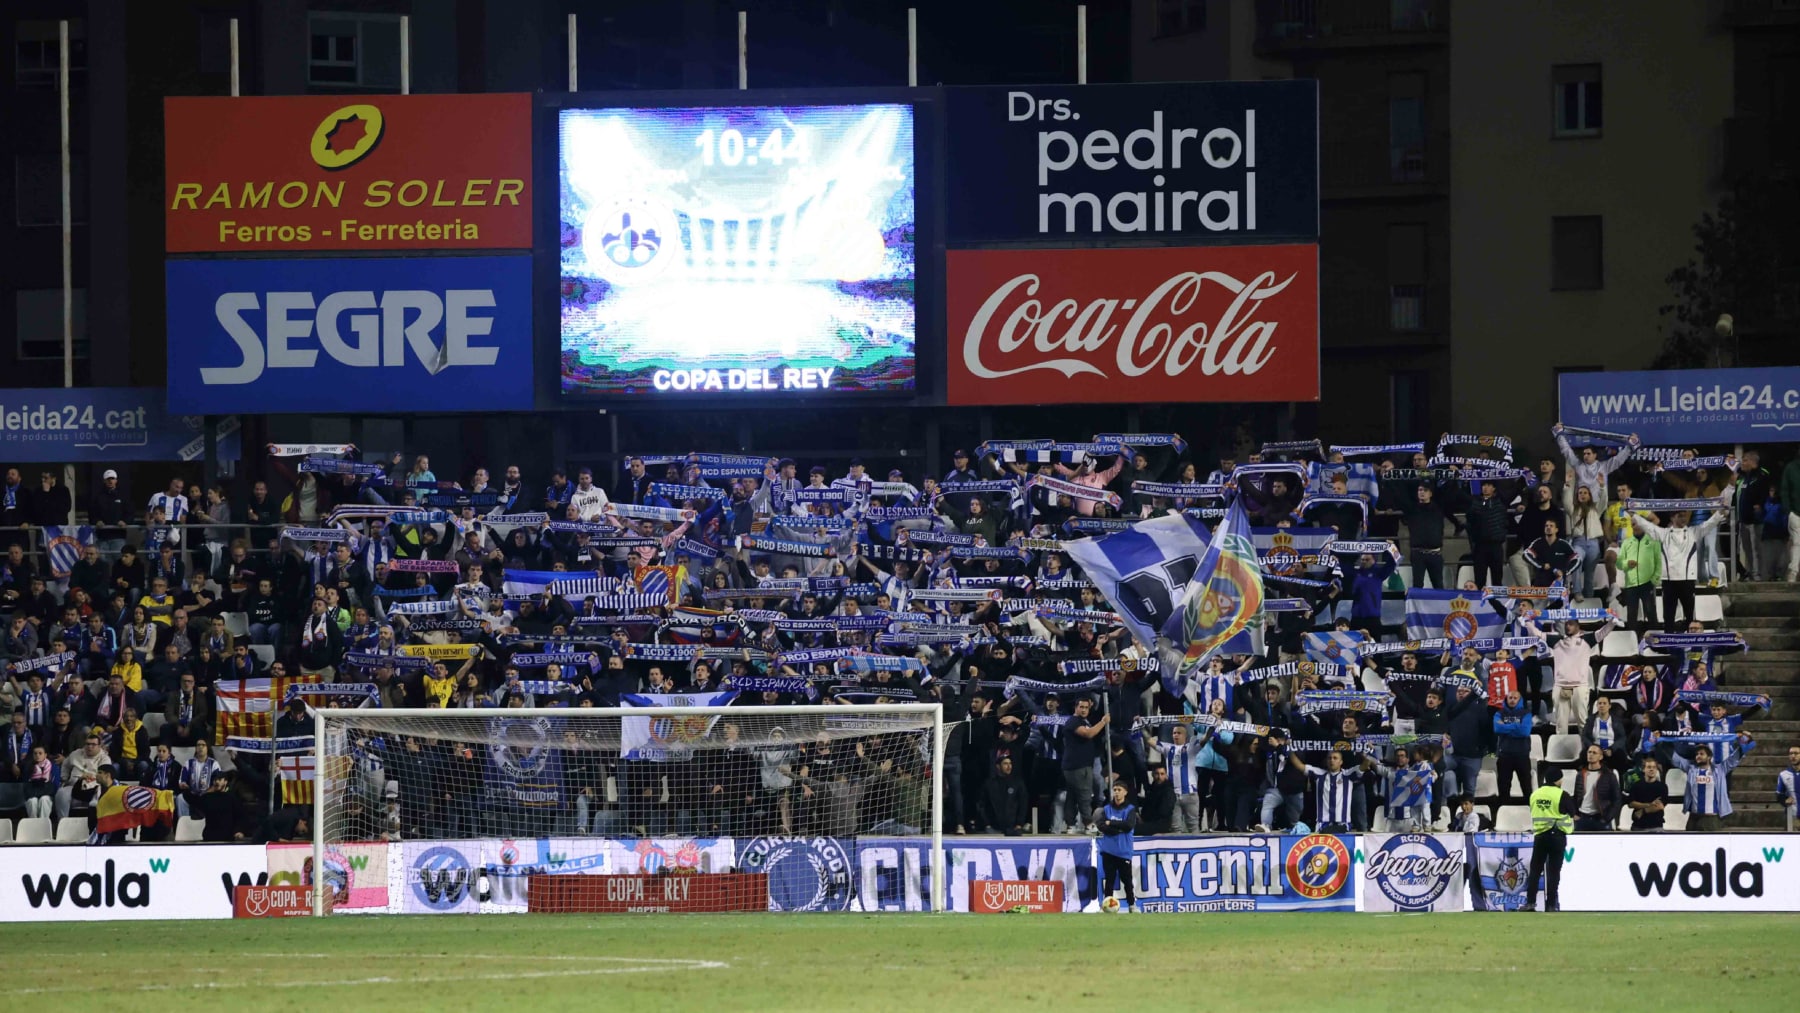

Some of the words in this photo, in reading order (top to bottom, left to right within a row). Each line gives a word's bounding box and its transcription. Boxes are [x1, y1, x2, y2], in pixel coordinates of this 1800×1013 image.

[1009, 91, 1079, 121] Drs.
[696, 130, 809, 166] 10:44
[1038, 110, 1256, 185] pedrol
[172, 181, 345, 210] RAMON
[365, 179, 524, 207] SOLER
[1038, 172, 1256, 232] mairal
[220, 221, 311, 242] Ferros
[341, 219, 479, 241] Ferreteria
[963, 271, 1298, 379] Coca-Cola
[200, 289, 499, 384] SEGRE
[653, 369, 725, 391] COPA
[729, 368, 777, 389] DEL
[783, 367, 834, 389] REY
[1591, 416, 1600, 425] El
[1604, 416, 1638, 425] primer
[1643, 414, 1675, 424] portal
[1680, 414, 1692, 422] de
[1696, 413, 1745, 423] podcasts
[22, 432, 69, 441] podcasts
[1124, 435, 1169, 443] ESPANYOL
[1076, 444, 1118, 452] ESPANYOL
[722, 457, 764, 465] ESPANYOL
[797, 492, 820, 500] RCDE
[822, 492, 843, 500] 1900
[1145, 486, 1173, 494] ESPANYOL
[945, 534, 972, 543] PERICO
[757, 539, 775, 551] RCD
[777, 542, 823, 556] ESPANYOL
[954, 547, 971, 556] RCD
[973, 547, 1015, 556] ESPANYOL
[1576, 607, 1599, 618] 1900
[1420, 638, 1449, 648] 1991
[513, 656, 532, 665] RCD
[534, 654, 587, 664] ESPANYOL
[643, 648, 671, 656] RCDE
[786, 653, 809, 662] RCD
[1072, 660, 1120, 672] JUVENIL
[1137, 657, 1160, 671] 1991
[1249, 662, 1298, 680] JUVENIL
[1314, 663, 1338, 675] 1991
[298, 683, 321, 691] PER
[324, 683, 368, 691] SEMPRE
[731, 677, 752, 687] RCD
[754, 677, 805, 689] ESPANYOL
[1493, 676, 1509, 696] 11
[1705, 692, 1752, 703] ESPANYOL
[1288, 739, 1334, 751] JUVENIL
[1293, 835, 1344, 858] JUVENIL
[1401, 835, 1426, 844] RCDE
[811, 836, 845, 884] RCDE
[1366, 850, 1463, 880] Juvenil
[1629, 847, 1763, 898] wala
[22, 858, 150, 908] wala
[607, 878, 644, 902] COPA
[664, 877, 690, 901] REY
[1303, 884, 1336, 897] 1991
[271, 890, 297, 907] COPA
[1006, 884, 1030, 902] COPA
[1038, 884, 1054, 902] REY
[1382, 881, 1407, 904] OFFICIAL
[1408, 881, 1444, 904] SUPPORTERS
